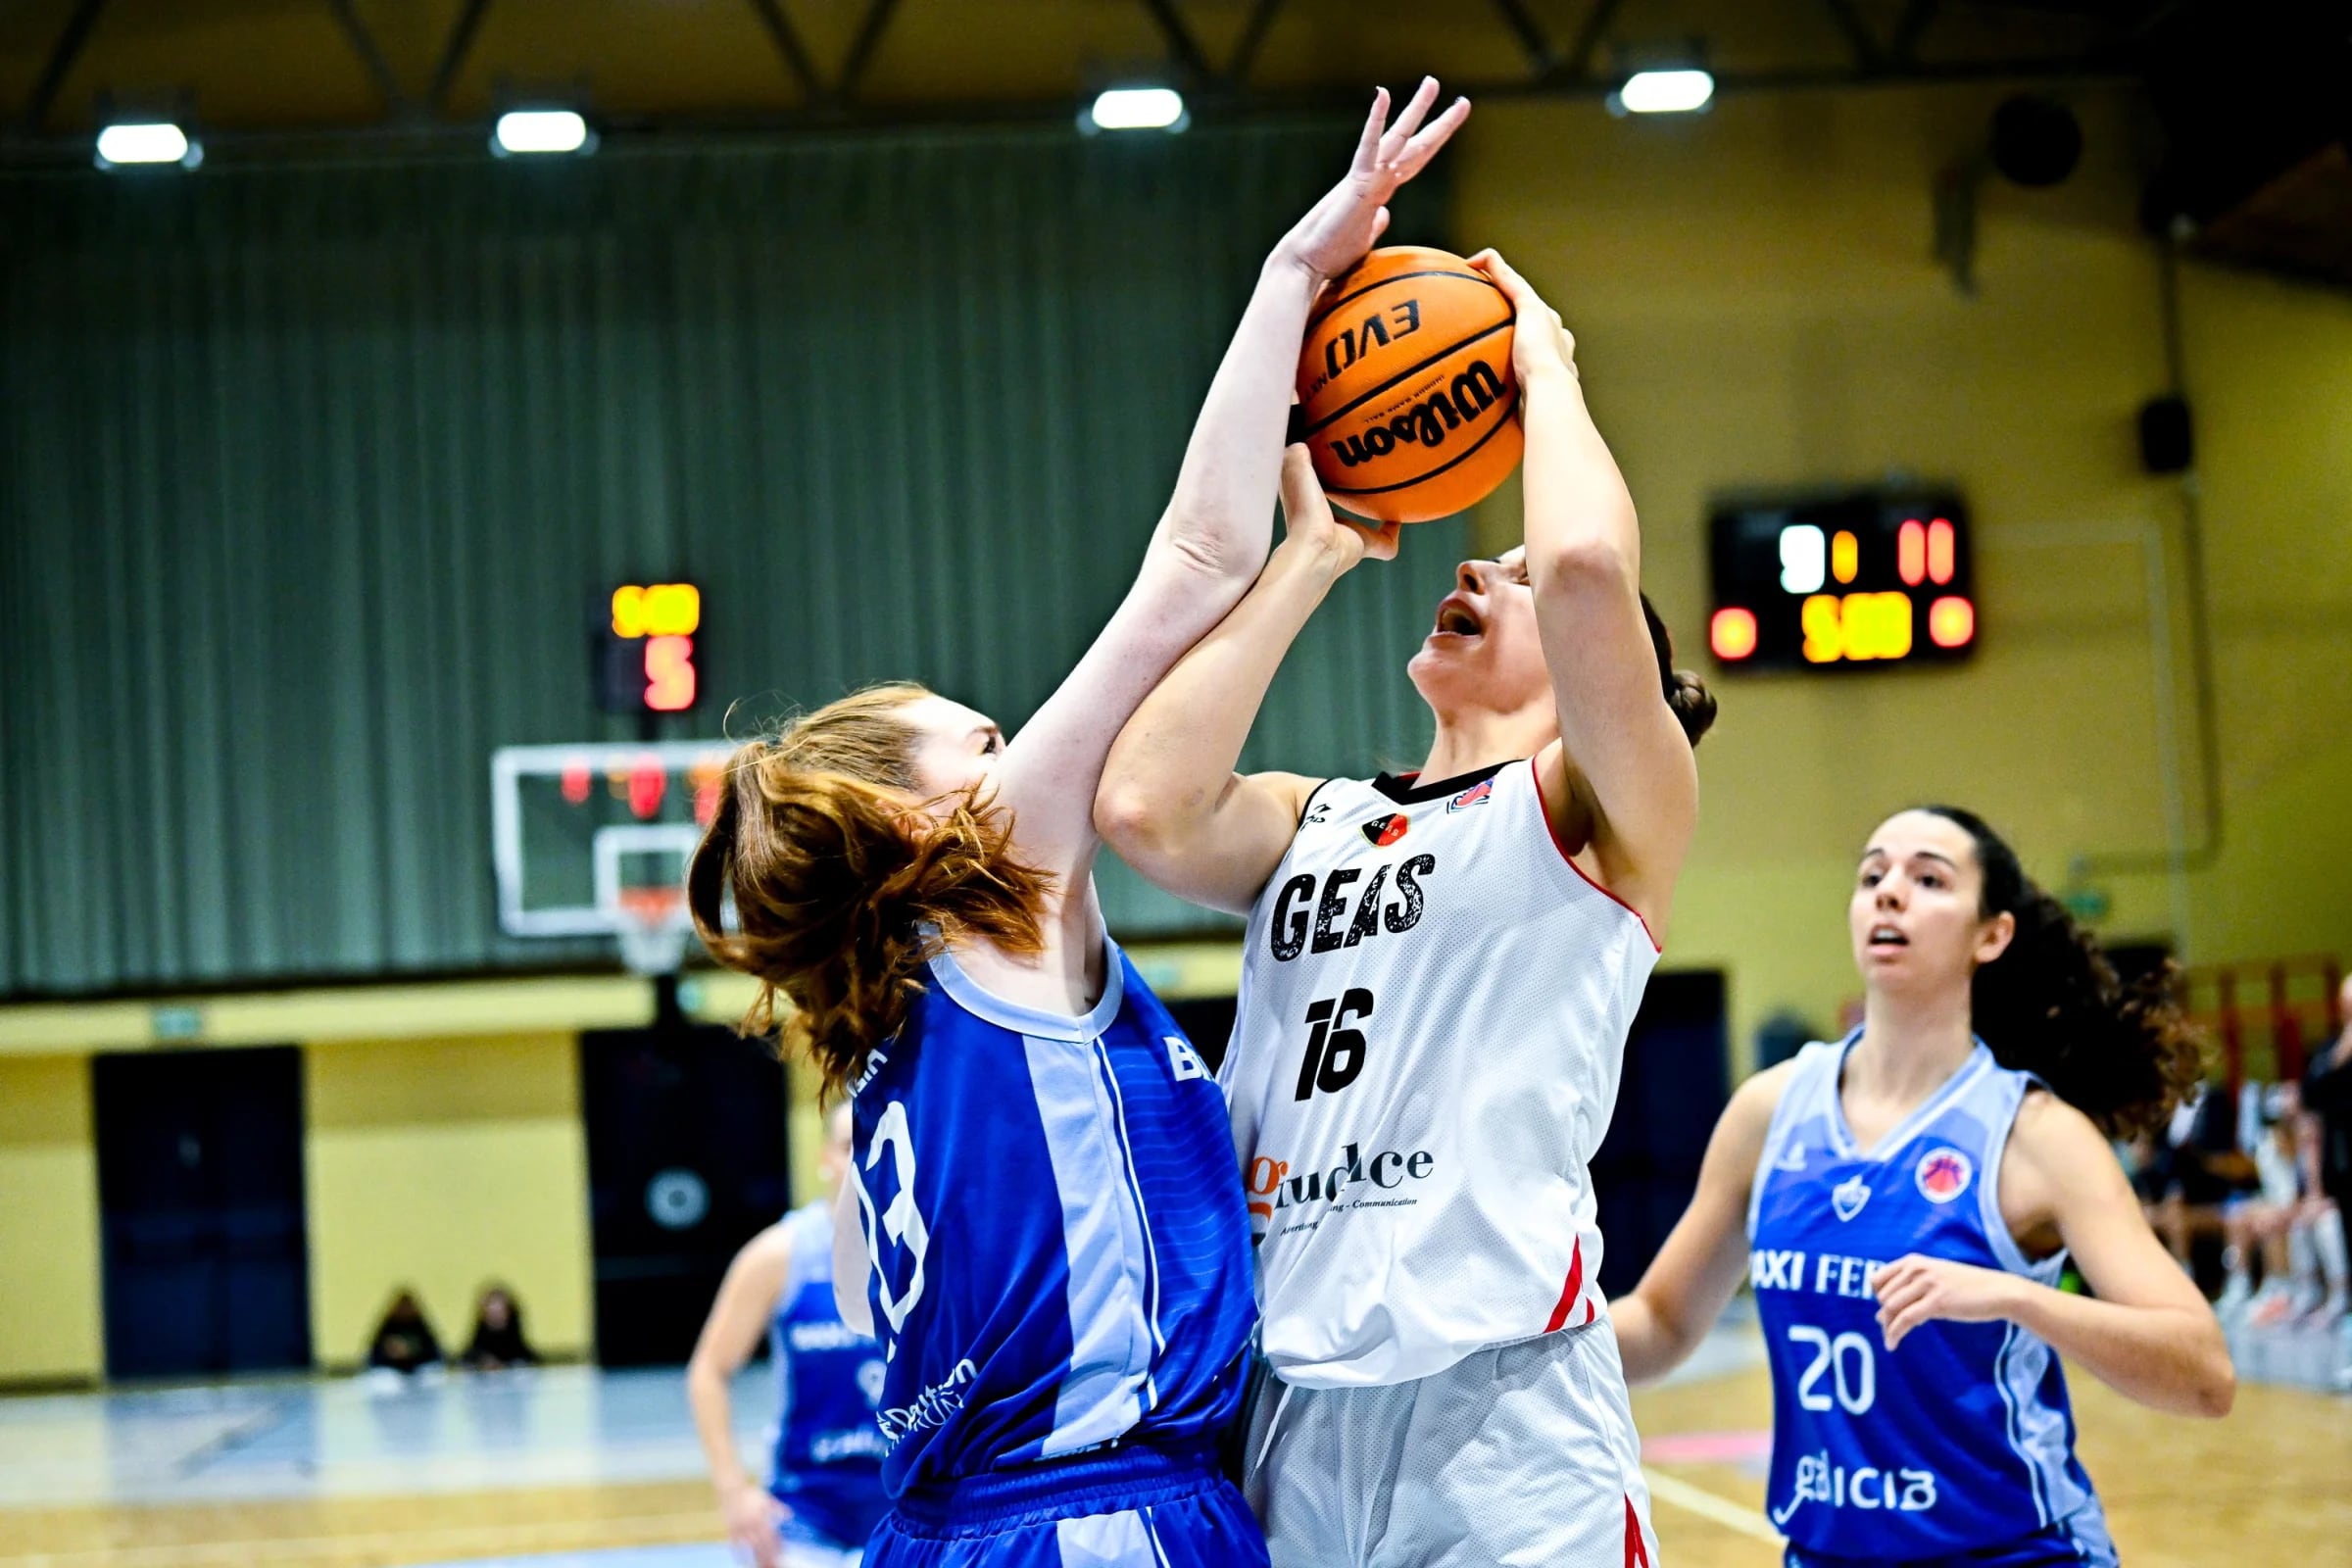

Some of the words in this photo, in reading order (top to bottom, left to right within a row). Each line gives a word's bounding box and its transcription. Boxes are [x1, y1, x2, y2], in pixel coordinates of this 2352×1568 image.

[1325, 298, 1421, 379] EVO
[1330, 359, 1508, 467] Wilson
[1270, 853, 1436, 962] GEAS
[1295, 987, 1374, 1102] 16
[1788, 1325, 1876, 1415] 20
